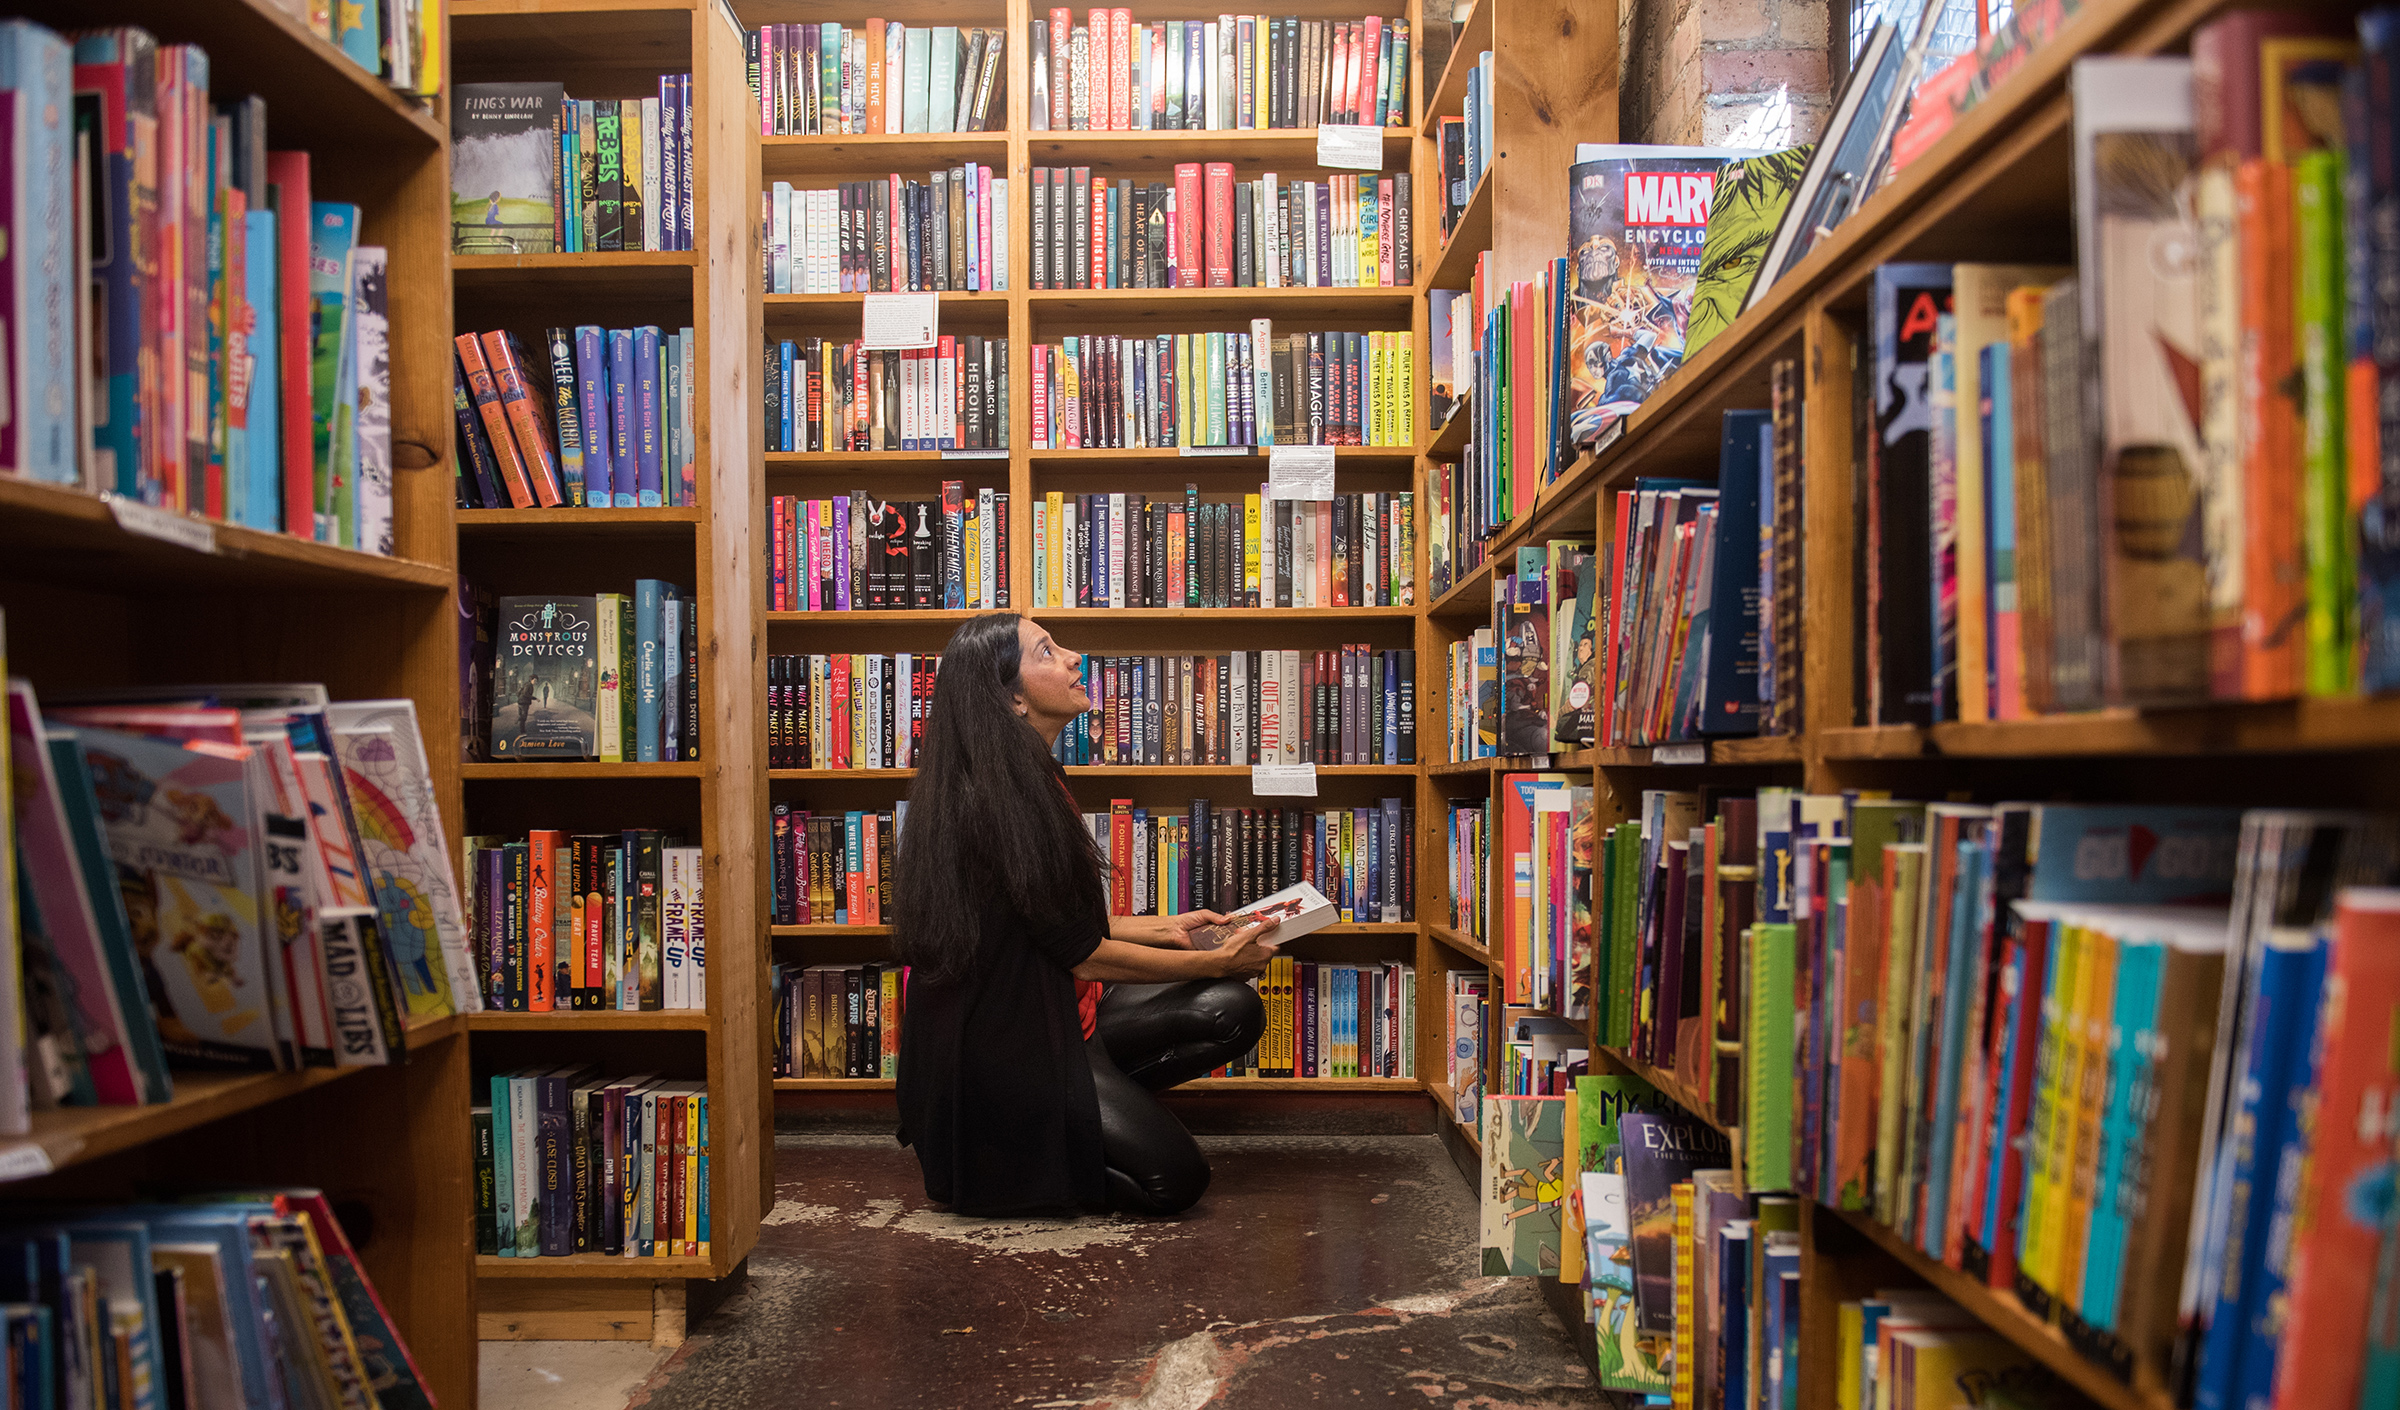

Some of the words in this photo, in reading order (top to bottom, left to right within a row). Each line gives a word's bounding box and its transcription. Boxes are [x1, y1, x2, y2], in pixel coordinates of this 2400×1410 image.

[1054, 22, 1064, 57] CROWN
[1367, 33, 1376, 48] Tin
[871, 61, 879, 79] THE
[1056, 59, 1062, 68] OF
[1365, 52, 1375, 77] Heart
[854, 63, 865, 101] SECRET
[466, 97, 505, 110] FING'S
[510, 97, 543, 109] WAR
[871, 83, 879, 106] HIVE
[1054, 72, 1064, 119] FEATHERS
[1132, 86, 1140, 110] BECK
[854, 103, 865, 121] SEA
[597, 116, 619, 183] REBELS
[581, 128, 594, 198] QUICKSAND
[1584, 176, 1602, 189] DK
[1076, 186, 1085, 206] THERE
[583, 200, 595, 236] POND
[856, 210, 864, 229] LIGHT
[1076, 207, 1085, 222] WILL
[1136, 203, 1144, 235] HEART
[1076, 224, 1085, 241] COME
[1293, 214, 1304, 260] FLAMES
[1399, 208, 1408, 269] CHRYSALIS
[1625, 229, 1705, 243] ENCYCLO
[857, 240, 865, 251] UP
[1137, 239, 1145, 252] OF
[1660, 247, 1682, 255] NEW
[1076, 248, 1085, 280] DARKNESS
[1137, 257, 1145, 281] IRON
[685, 342, 693, 357] Lexi
[1259, 331, 1267, 357] Again,
[684, 359, 694, 386] Magill
[856, 349, 867, 381] CAMP
[643, 380, 651, 391] For
[1034, 373, 1044, 404] REBELS
[1260, 372, 1268, 398] Better
[643, 392, 651, 409] Black
[857, 383, 867, 418] VALOR
[968, 363, 979, 433] HEROINE
[1311, 377, 1322, 426] MAGIC
[1035, 407, 1045, 425] LIKE
[1035, 428, 1045, 438] US
[644, 445, 652, 453] Me
[1037, 510, 1045, 529] frat
[1380, 514, 1388, 530] KEEP
[946, 510, 962, 581] ARCHENEMIES
[1035, 533, 1045, 550] girl
[1381, 548, 1388, 556] TO
[798, 560, 804, 568] TO
[1099, 566, 1105, 574] OF
[1171, 530, 1181, 596] ALLEGIANT
[509, 632, 587, 642] MONSTROUS
[512, 645, 584, 656] DEVICES
[644, 641, 655, 671] Charlie
[667, 645, 675, 662] THE
[644, 673, 653, 687] and
[912, 672, 921, 696] TAKE
[644, 689, 655, 704] Me
[667, 695, 676, 714] BOY
[799, 685, 807, 705] WHAT
[1220, 685, 1228, 712] border
[912, 699, 921, 718] THE
[799, 709, 807, 734] MAKES
[912, 720, 921, 738] MIC
[1118, 698, 1129, 744] CALAMITY
[799, 736, 807, 746] US
[1225, 827, 1233, 846] BONE
[1355, 833, 1365, 857] MIND
[1224, 848, 1233, 886] CHARMER
[1389, 855, 1396, 866] OF
[1356, 860, 1365, 890] GAMES
[532, 887, 547, 923] Batting
[671, 889, 681, 902] THE
[535, 928, 547, 958] Order
[665, 902, 685, 967] FRAME-UP
[323, 922, 358, 977] MAD
[1283, 999, 1292, 1025] Radical
[335, 1006, 375, 1055] LIBS
[1283, 1028, 1292, 1059] Element
[546, 1138, 556, 1158] CASE
[547, 1160, 557, 1190] CLOSED
[605, 1159, 613, 1174] FIND
[605, 1176, 614, 1185] ME
